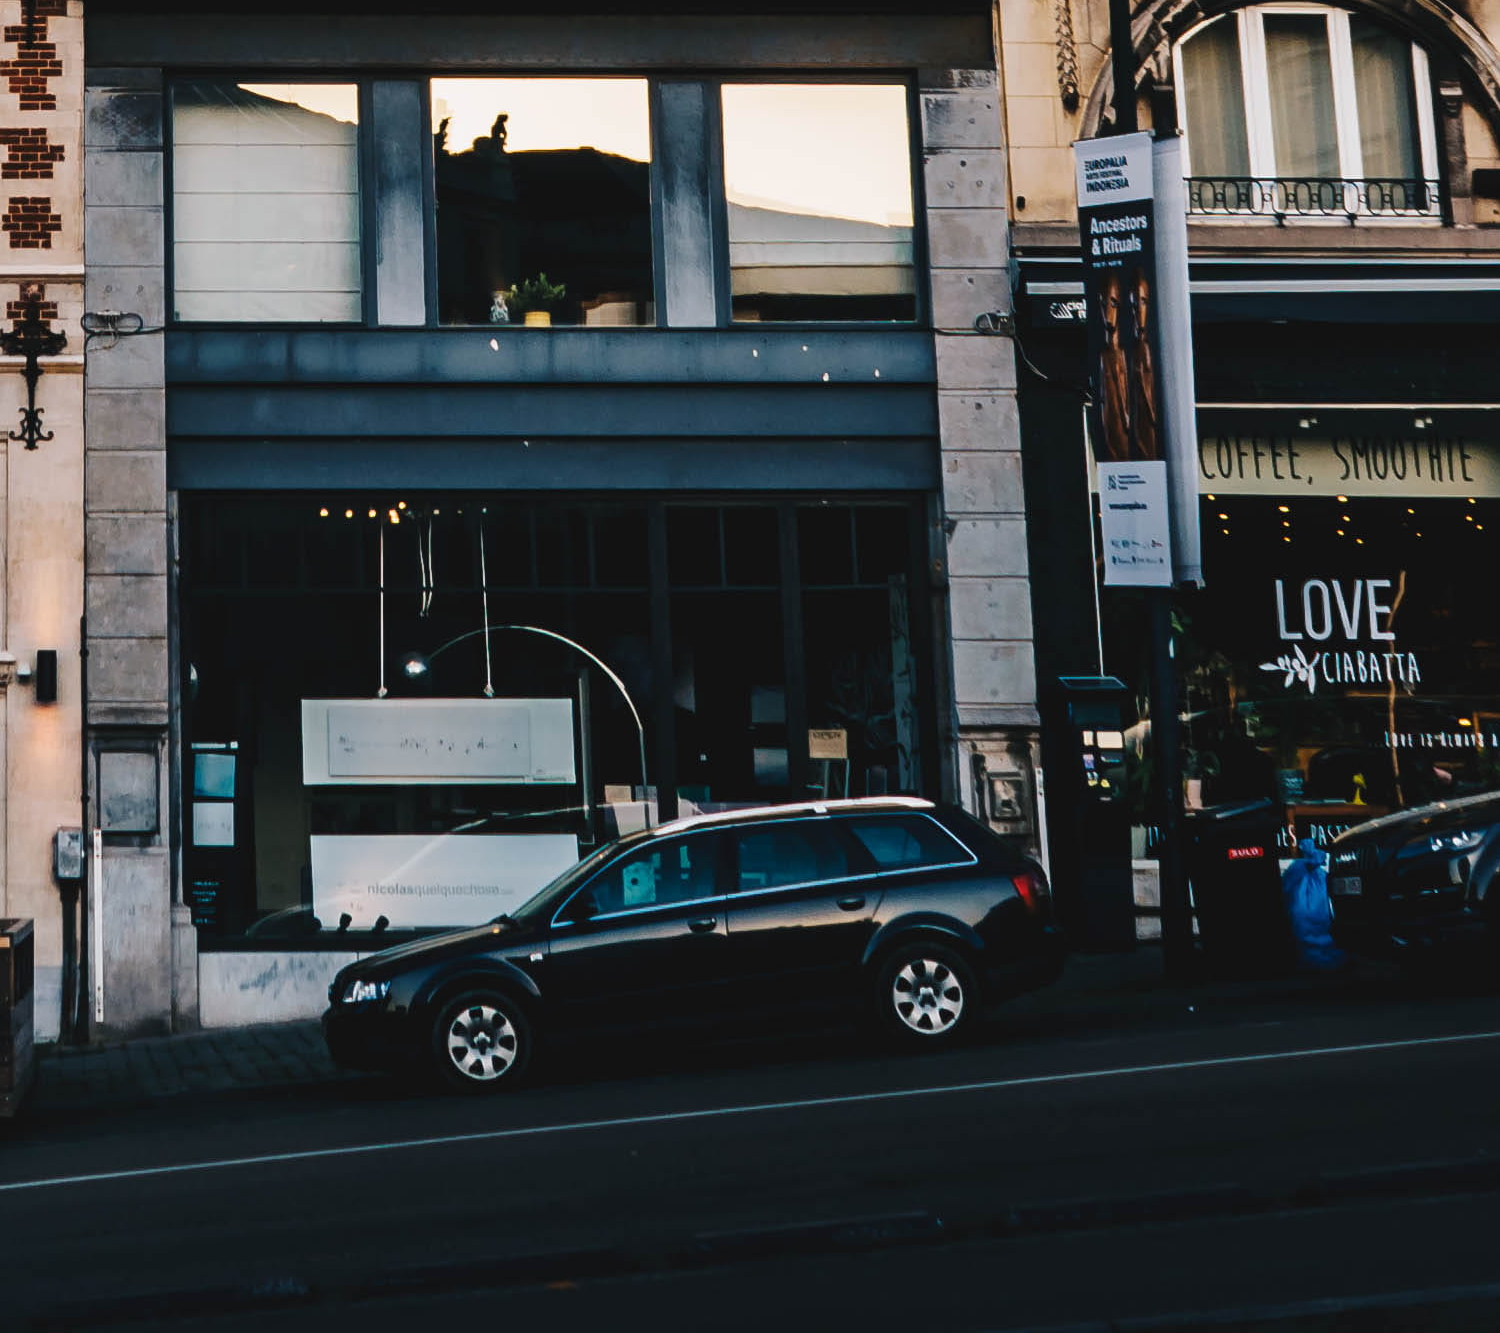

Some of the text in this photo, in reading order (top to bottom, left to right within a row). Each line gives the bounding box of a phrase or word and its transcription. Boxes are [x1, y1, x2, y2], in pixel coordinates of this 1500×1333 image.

[1083, 155, 1128, 172] EUROPALIA
[1086, 178, 1130, 193] INDONESIA
[1090, 214, 1148, 234] Ancestors
[1091, 233, 1143, 256] & Rituals
[1199, 433, 1313, 485] COFFEE,
[1332, 433, 1474, 482] SMOOTHIE
[1274, 579, 1397, 641] LOVE
[1321, 651, 1421, 684] CIABATTA
